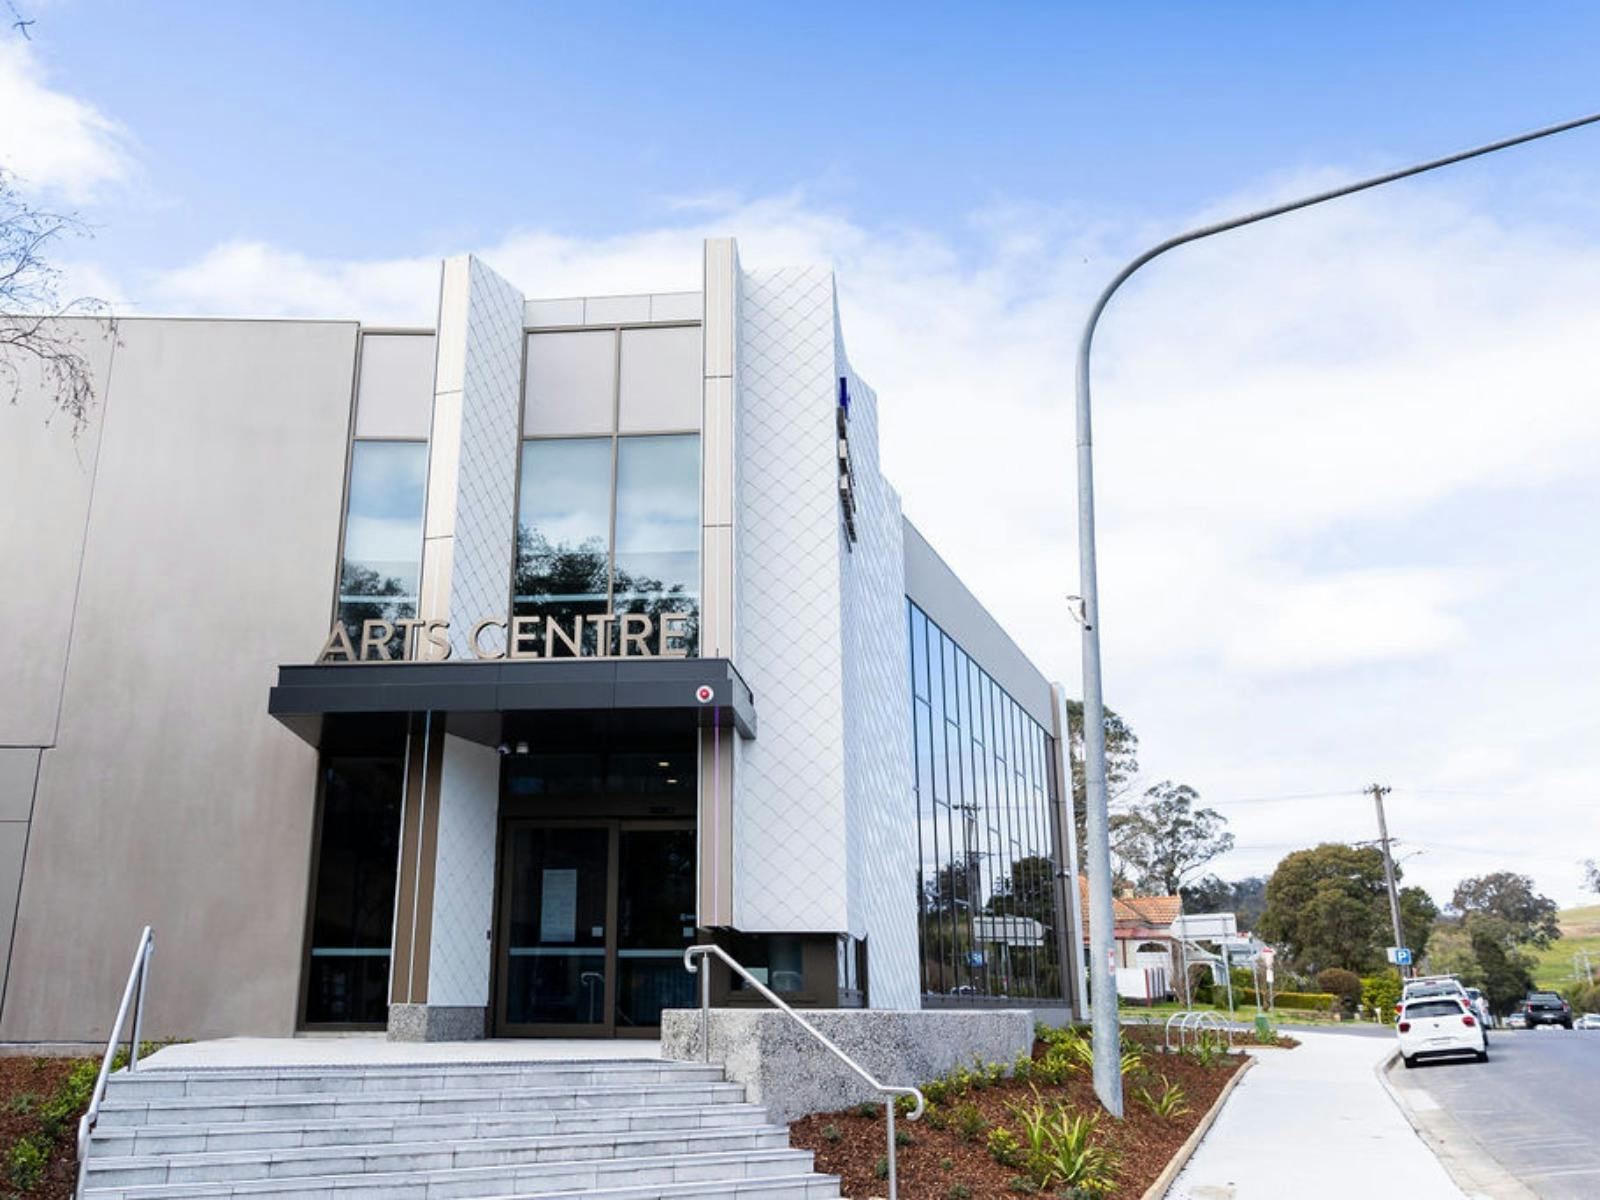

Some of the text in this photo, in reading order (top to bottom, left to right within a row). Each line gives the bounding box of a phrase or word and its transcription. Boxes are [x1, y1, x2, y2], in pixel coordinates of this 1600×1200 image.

[318, 612, 688, 663] ARTS CENTRE
[1398, 951, 1407, 962] P
